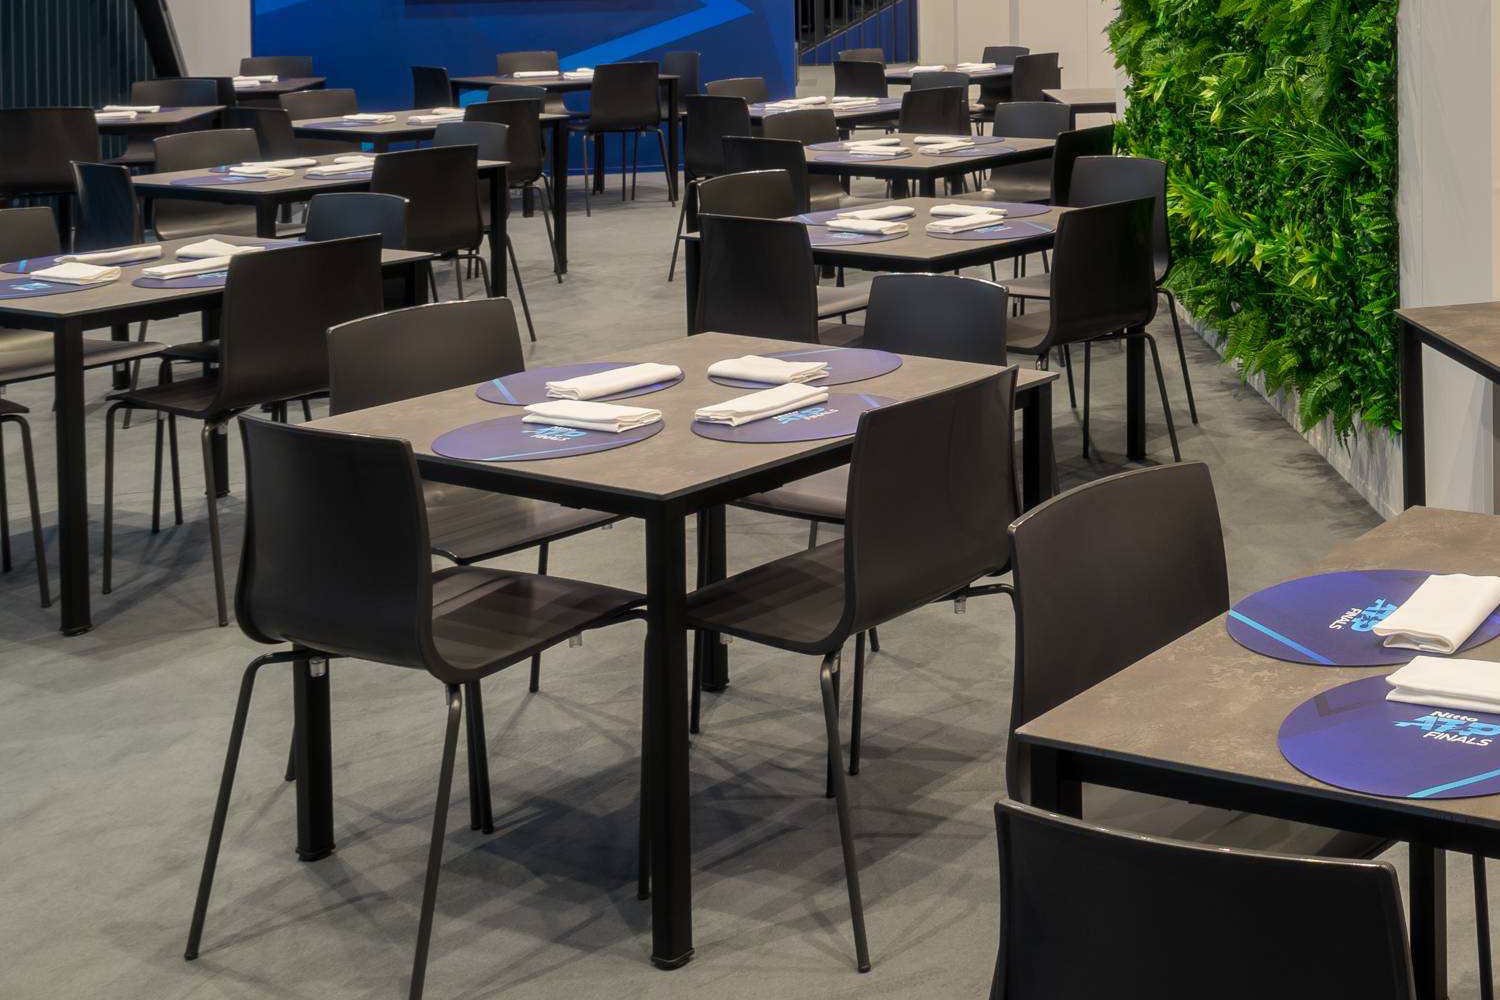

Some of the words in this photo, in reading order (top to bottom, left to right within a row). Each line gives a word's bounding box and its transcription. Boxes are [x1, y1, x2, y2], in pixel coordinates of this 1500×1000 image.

[1328, 607, 1362, 630] FINALS
[1429, 710, 1478, 722] Nitto
[1423, 731, 1493, 746] FINALS
